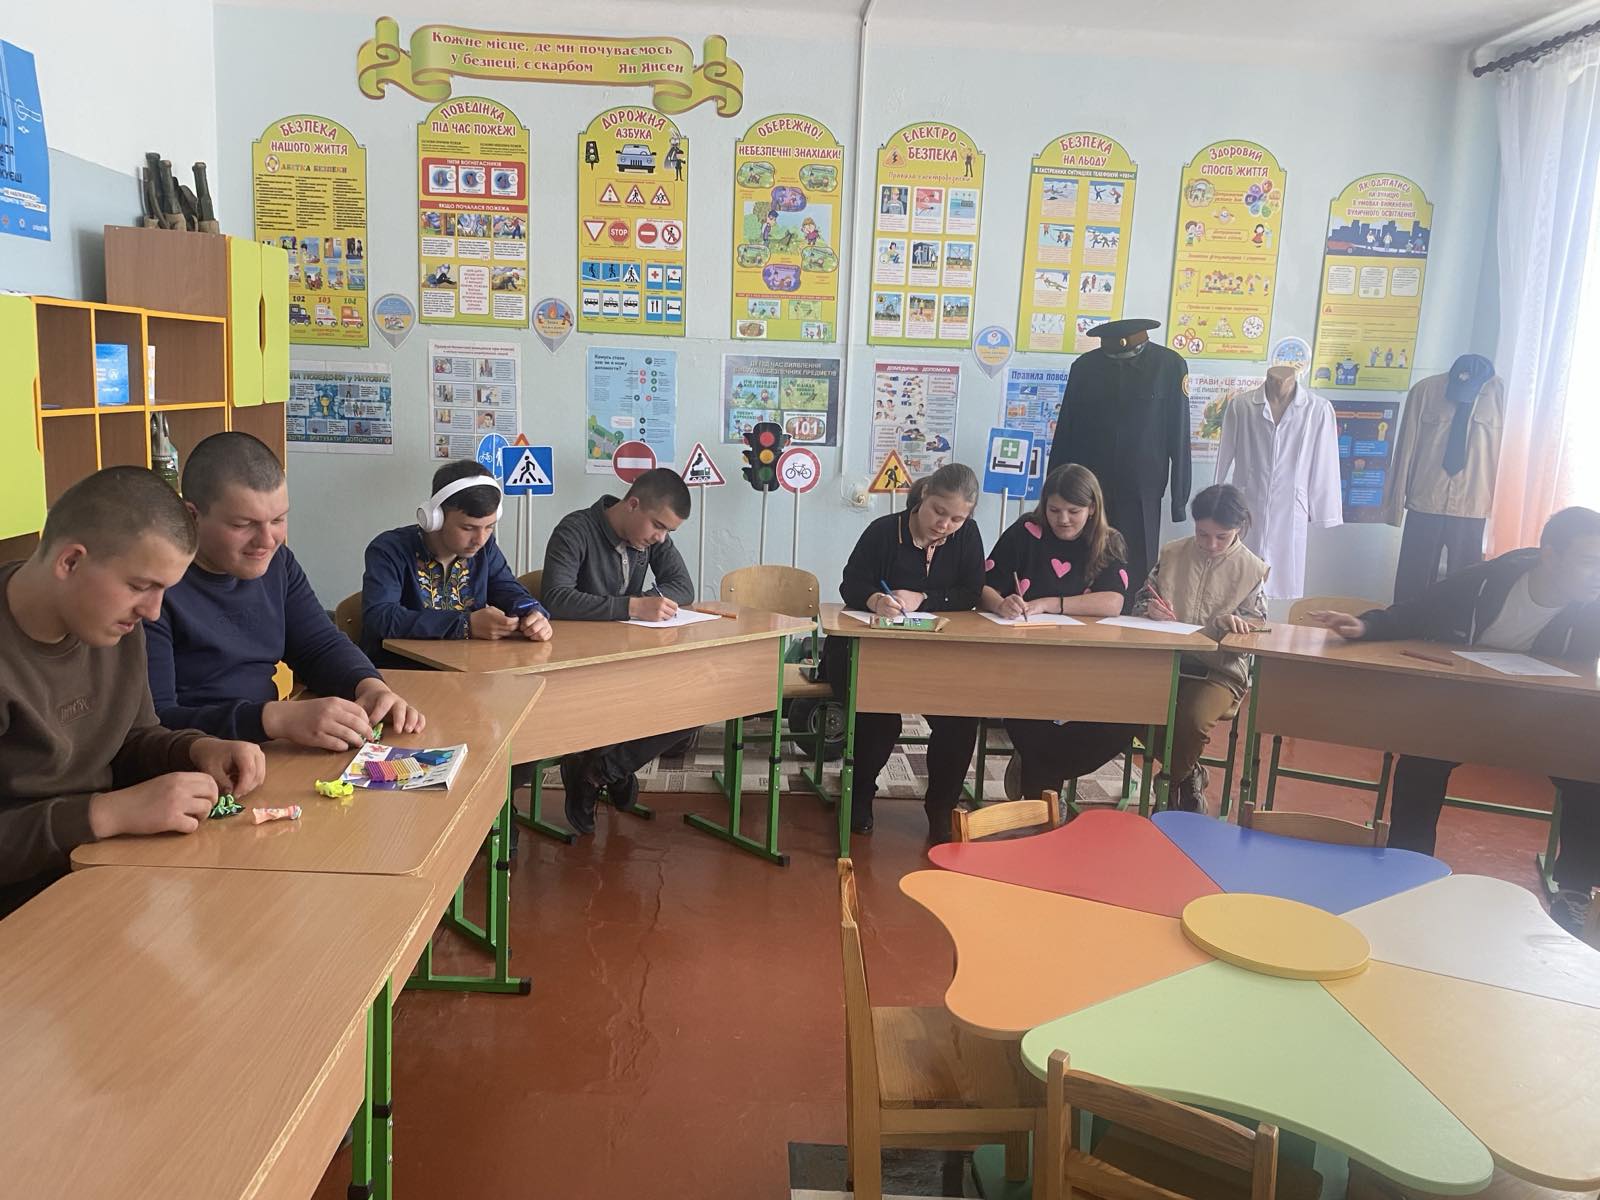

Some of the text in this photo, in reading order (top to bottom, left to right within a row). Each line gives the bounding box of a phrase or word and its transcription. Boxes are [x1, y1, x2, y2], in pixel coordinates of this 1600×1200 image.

[432, 31, 673, 57] Кожне місце, де ми почуваємось
[450, 54, 458, 66] у
[535, 59, 594, 74] скарбом
[618, 62, 637, 74] Ян
[641, 62, 684, 75] Янсен
[441, 101, 505, 122] ПОВЕДІНКА
[601, 110, 666, 130] ДОРОЖНЯ
[280, 120, 337, 140] БЕЗПЕКА
[432, 122, 516, 136] ПІД ЧАС ПОЖЕЖІ
[615, 128, 652, 140] АЗБУКА
[758, 119, 823, 140] ОБЕРЕЖНО!
[271, 141, 348, 155] НАШОГО ЖИТТЯ
[739, 145, 841, 159] НЕБЕЗПЕЧНІ ЗНАХІДКИ!
[1060, 136, 1113, 154] БЕЗПЕКА
[908, 147, 958, 161] БЕЗПЕКА
[1063, 155, 1107, 167] НА ЛЬОДУ
[1209, 146, 1263, 162] Здоровий
[1201, 165, 1268, 177] СПОСІБ ЖИТТЯ
[1358, 182, 1370, 191] ЯК
[610, 228, 628, 237] STOP
[1011, 370, 1044, 381] Правила
[1195, 378, 1265, 387] ТРАВИ ЦЕ ЗЛОЧИ
[794, 421, 818, 435] 101
